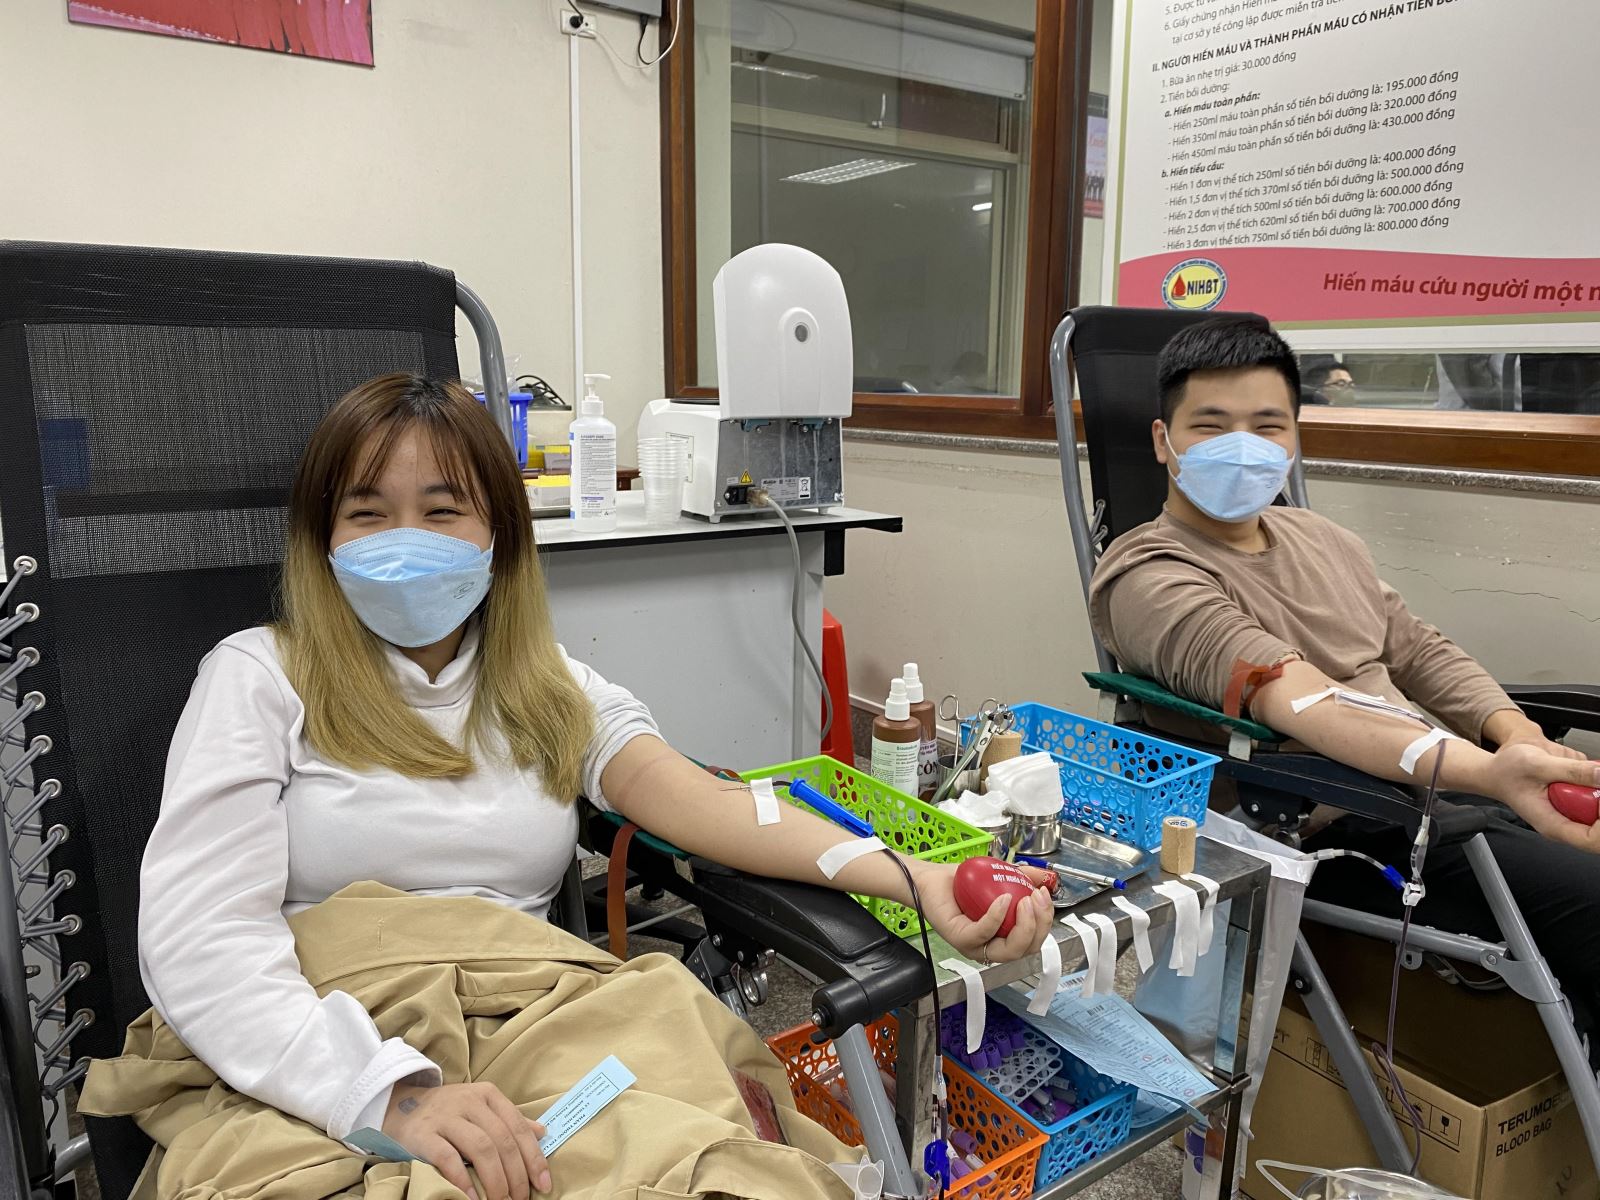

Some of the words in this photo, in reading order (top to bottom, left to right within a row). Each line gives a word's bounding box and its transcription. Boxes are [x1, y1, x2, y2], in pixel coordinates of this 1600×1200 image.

[1161, 54, 1190, 69] NGƯỜI
[1192, 49, 1214, 62] HIẾN
[1215, 43, 1237, 56] MÁU
[1254, 31, 1289, 47] THÀNH
[1291, 22, 1321, 39] PHẦN
[1323, 16, 1349, 31] MÁU
[1369, 3, 1404, 20] NHẬN
[1172, 135, 1190, 145] Hiến
[1191, 130, 1217, 143] 350ml
[1218, 127, 1237, 138] máu
[1238, 124, 1258, 135] toàn
[1259, 118, 1283, 133] phần
[1297, 113, 1315, 125] tiền
[1317, 109, 1333, 121] bồi
[1334, 105, 1367, 118] dưỡng
[1369, 101, 1381, 112] là:
[1384, 93, 1425, 109] 320.000
[1427, 88, 1456, 102] đồng
[1173, 119, 1191, 130] Hiến
[1192, 114, 1218, 127] 250ml
[1219, 111, 1238, 122] máu
[1239, 108, 1259, 119] toàn
[1261, 102, 1284, 117] phần
[1298, 96, 1316, 108] tiền
[1318, 91, 1334, 104] bồi
[1336, 88, 1369, 100] dưỡng
[1371, 83, 1383, 94] là:
[1386, 75, 1427, 91] 195.000
[1429, 70, 1458, 83] đồng
[1171, 150, 1189, 161] Hiến
[1191, 146, 1216, 157] 450ml
[1217, 143, 1236, 154] máu
[1237, 140, 1257, 151] toàn
[1258, 135, 1281, 149] phần
[1295, 130, 1314, 141] tiền
[1315, 126, 1331, 138] bồi
[1333, 123, 1366, 135] dưỡng
[1368, 119, 1380, 130] là:
[1382, 111, 1423, 126] 430.000
[1425, 107, 1455, 120] đồng
[1170, 180, 1188, 191] Hiến
[1195, 178, 1212, 188] đơn
[1222, 172, 1237, 184] thể
[1238, 171, 1254, 182] tích
[1255, 167, 1283, 180] 250ml
[1297, 163, 1315, 174] tiền
[1317, 160, 1332, 171] bồi
[1334, 157, 1367, 169] dưỡng
[1369, 153, 1381, 164] là:
[1383, 147, 1424, 162] 400.000
[1426, 143, 1456, 156] đồng
[1262, 182, 1289, 195] 370ml
[1390, 164, 1432, 178] 500.000
[1168, 210, 1186, 220] Hiến
[1194, 208, 1210, 218] đơn
[1220, 203, 1235, 215] thể
[1235, 203, 1252, 213] tích
[1253, 199, 1281, 211] 500ml
[1294, 195, 1312, 207] tiền
[1314, 193, 1330, 204] bồi
[1331, 191, 1364, 202] dưỡng
[1366, 188, 1378, 198] là:
[1380, 183, 1421, 197] 600.000
[1423, 179, 1452, 192] đồng
[1259, 214, 1287, 226] 620ml
[1388, 199, 1429, 212] 700.000
[1252, 231, 1279, 242] 750ml
[1377, 218, 1418, 231] 800.000
[1187, 278, 1218, 296] NIHBT
[1323, 271, 1366, 292] Hiến
[1370, 274, 1414, 294] máu
[1419, 276, 1457, 296] cứu
[1462, 279, 1529, 302] người
[1533, 281, 1583, 307] một
[1496, 1130, 1531, 1157] BLOOD
[1533, 1118, 1552, 1139] BAG
